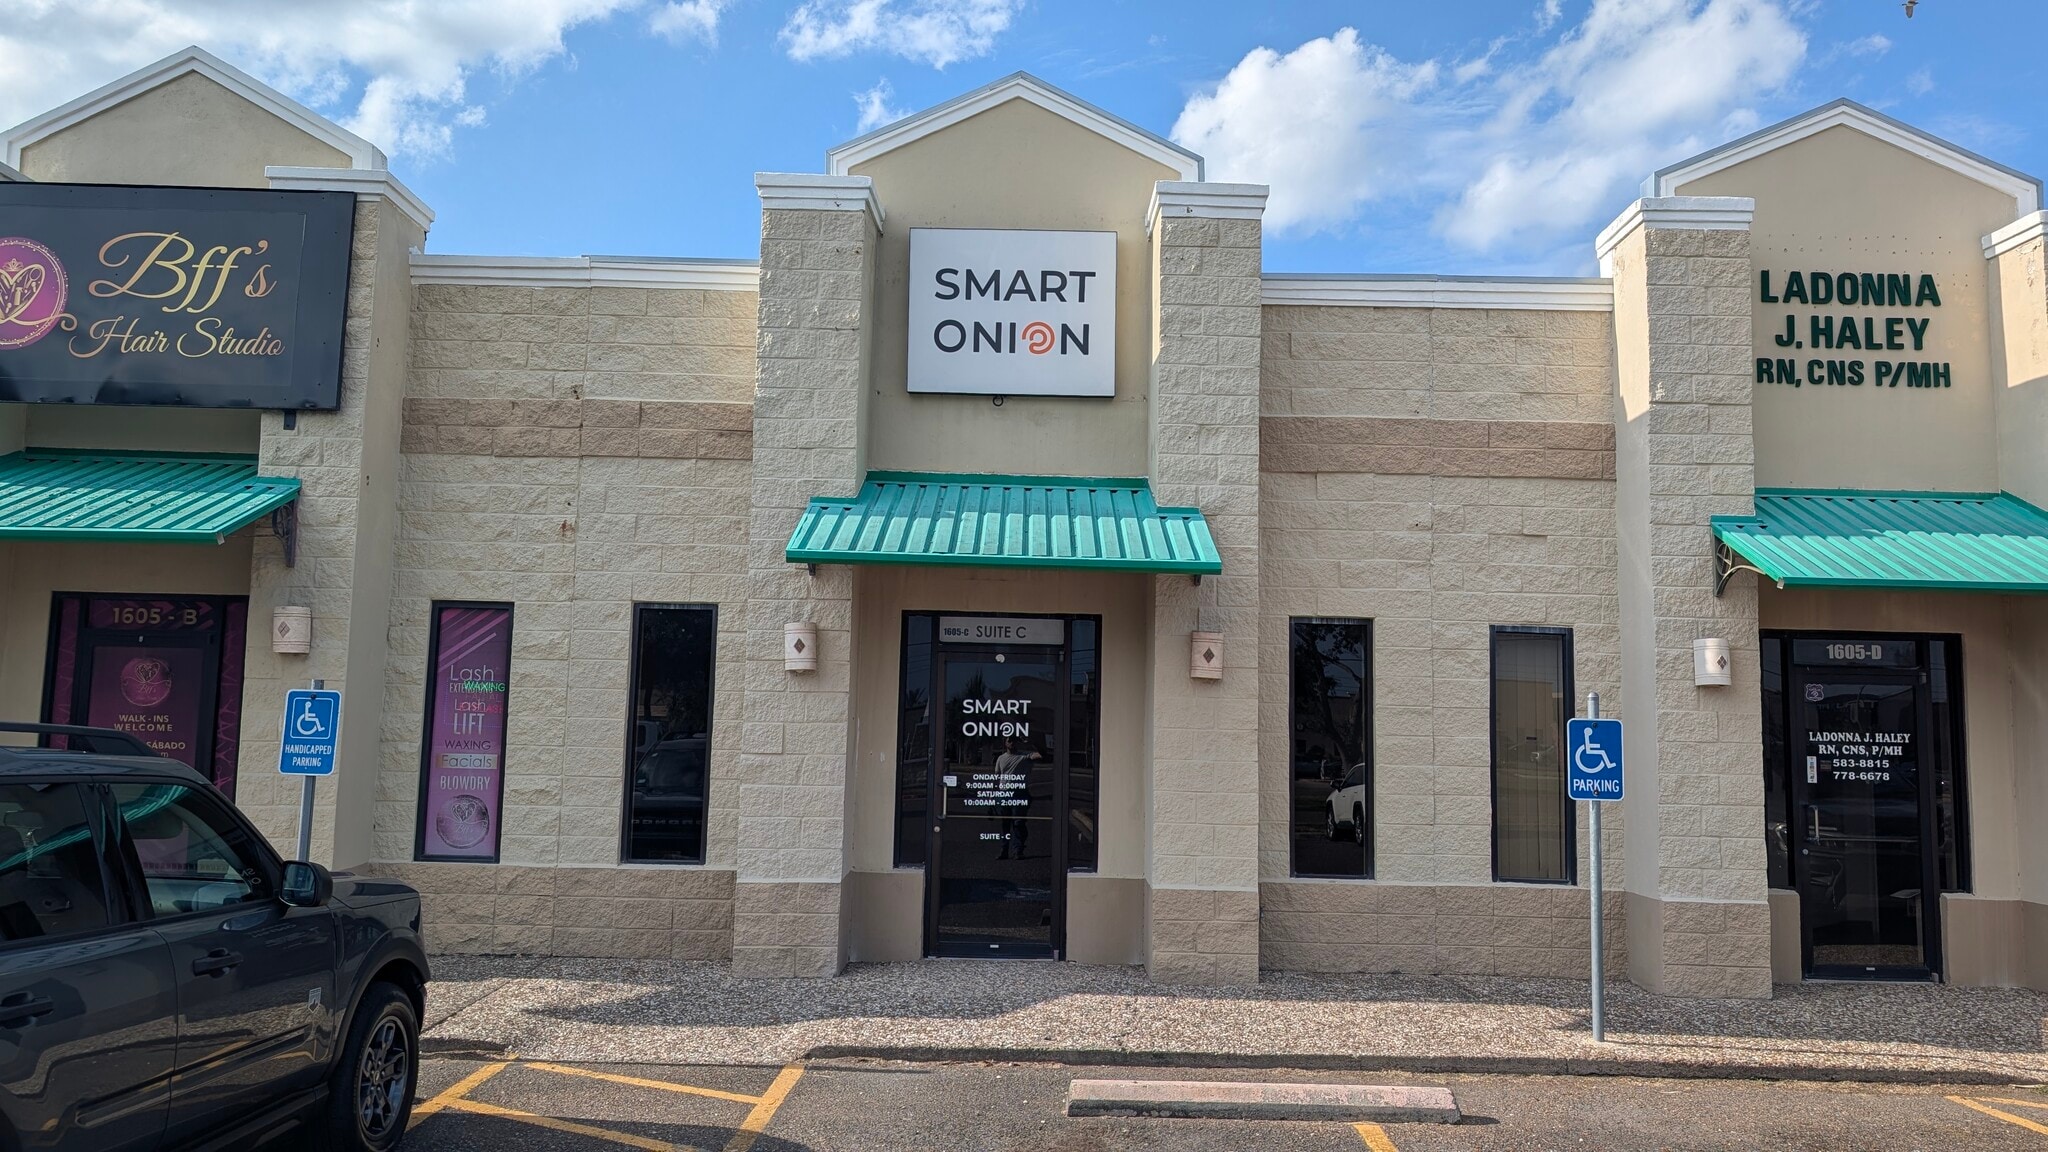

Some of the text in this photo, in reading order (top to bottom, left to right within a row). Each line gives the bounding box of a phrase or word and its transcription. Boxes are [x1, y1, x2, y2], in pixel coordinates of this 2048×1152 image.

[88, 231, 278, 314] Bff's
[934, 268, 1096, 303] SMART
[1760, 269, 1942, 307] LADONNA
[68, 315, 286, 359] Hair Studio
[933, 319, 1090, 355] ONION
[1774, 314, 1930, 351] J. HALEY
[1874, 361, 1951, 388] P/MH
[113, 607, 161, 624] 1605
[183, 609, 197, 625] B
[943, 625, 1027, 638] 1605-C SUITE C
[1825, 644, 1882, 660] 1605-D
[450, 664, 494, 681] Lash
[464, 680, 506, 692] WAXING
[454, 698, 486, 711] Lash
[962, 699, 1032, 715] SMART
[119, 714, 146, 723] WALK
[153, 715, 169, 723] INS
[453, 712, 485, 735] LIFT
[114, 723, 173, 732] WELCOME
[962, 721, 1029, 737] ONION
[1808, 731, 1911, 743] LADONNA J. HALEY
[285, 744, 332, 755] HANDICAPPED
[444, 740, 491, 750] WAXING
[1818, 744, 1903, 757] RN, CNS, P/MH
[292, 757, 322, 767] PARKING
[441, 754, 492, 768] Facials
[1832, 759, 1890, 768] 583-8815
[440, 775, 491, 791] BLOWDRY
[1832, 771, 1890, 781] 778-6678
[1573, 778, 1620, 793] PARKING
